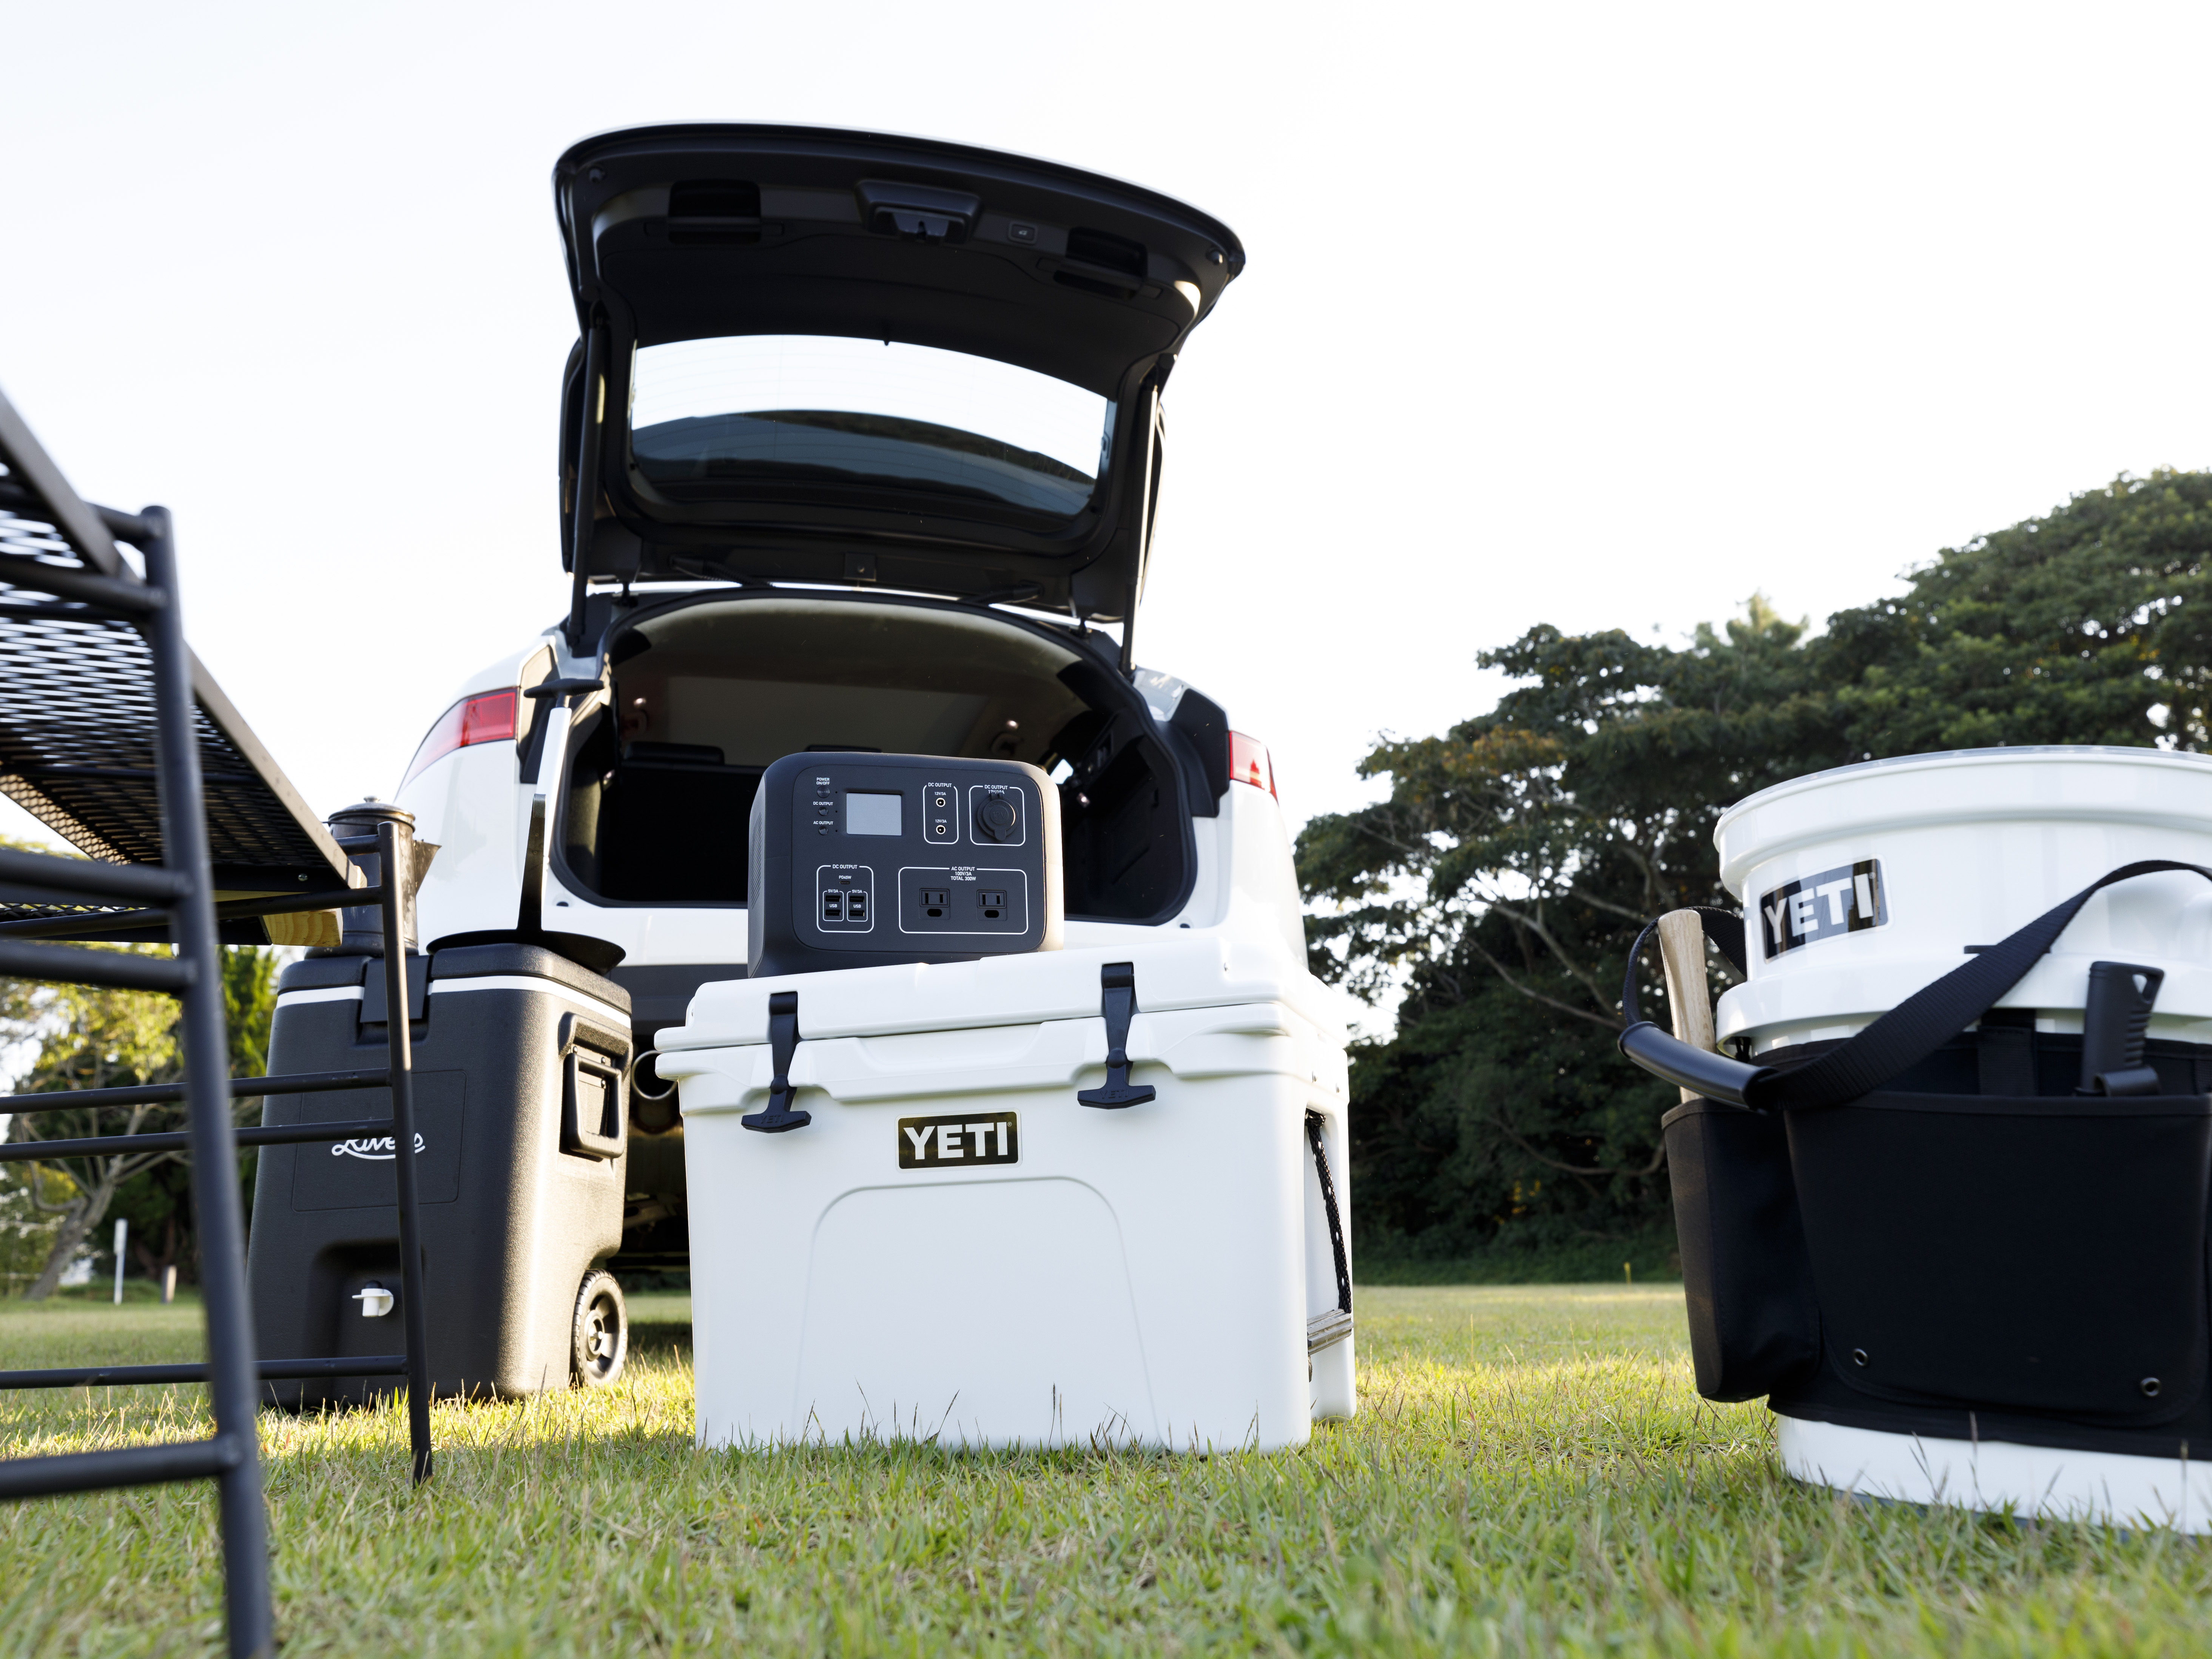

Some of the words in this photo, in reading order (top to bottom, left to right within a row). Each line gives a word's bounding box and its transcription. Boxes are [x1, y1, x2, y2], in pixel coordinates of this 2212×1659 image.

[993, 811, 1006, 819] 12V
[1100, 1090, 1128, 1099] YETI
[761, 1115, 784, 1124] YETI
